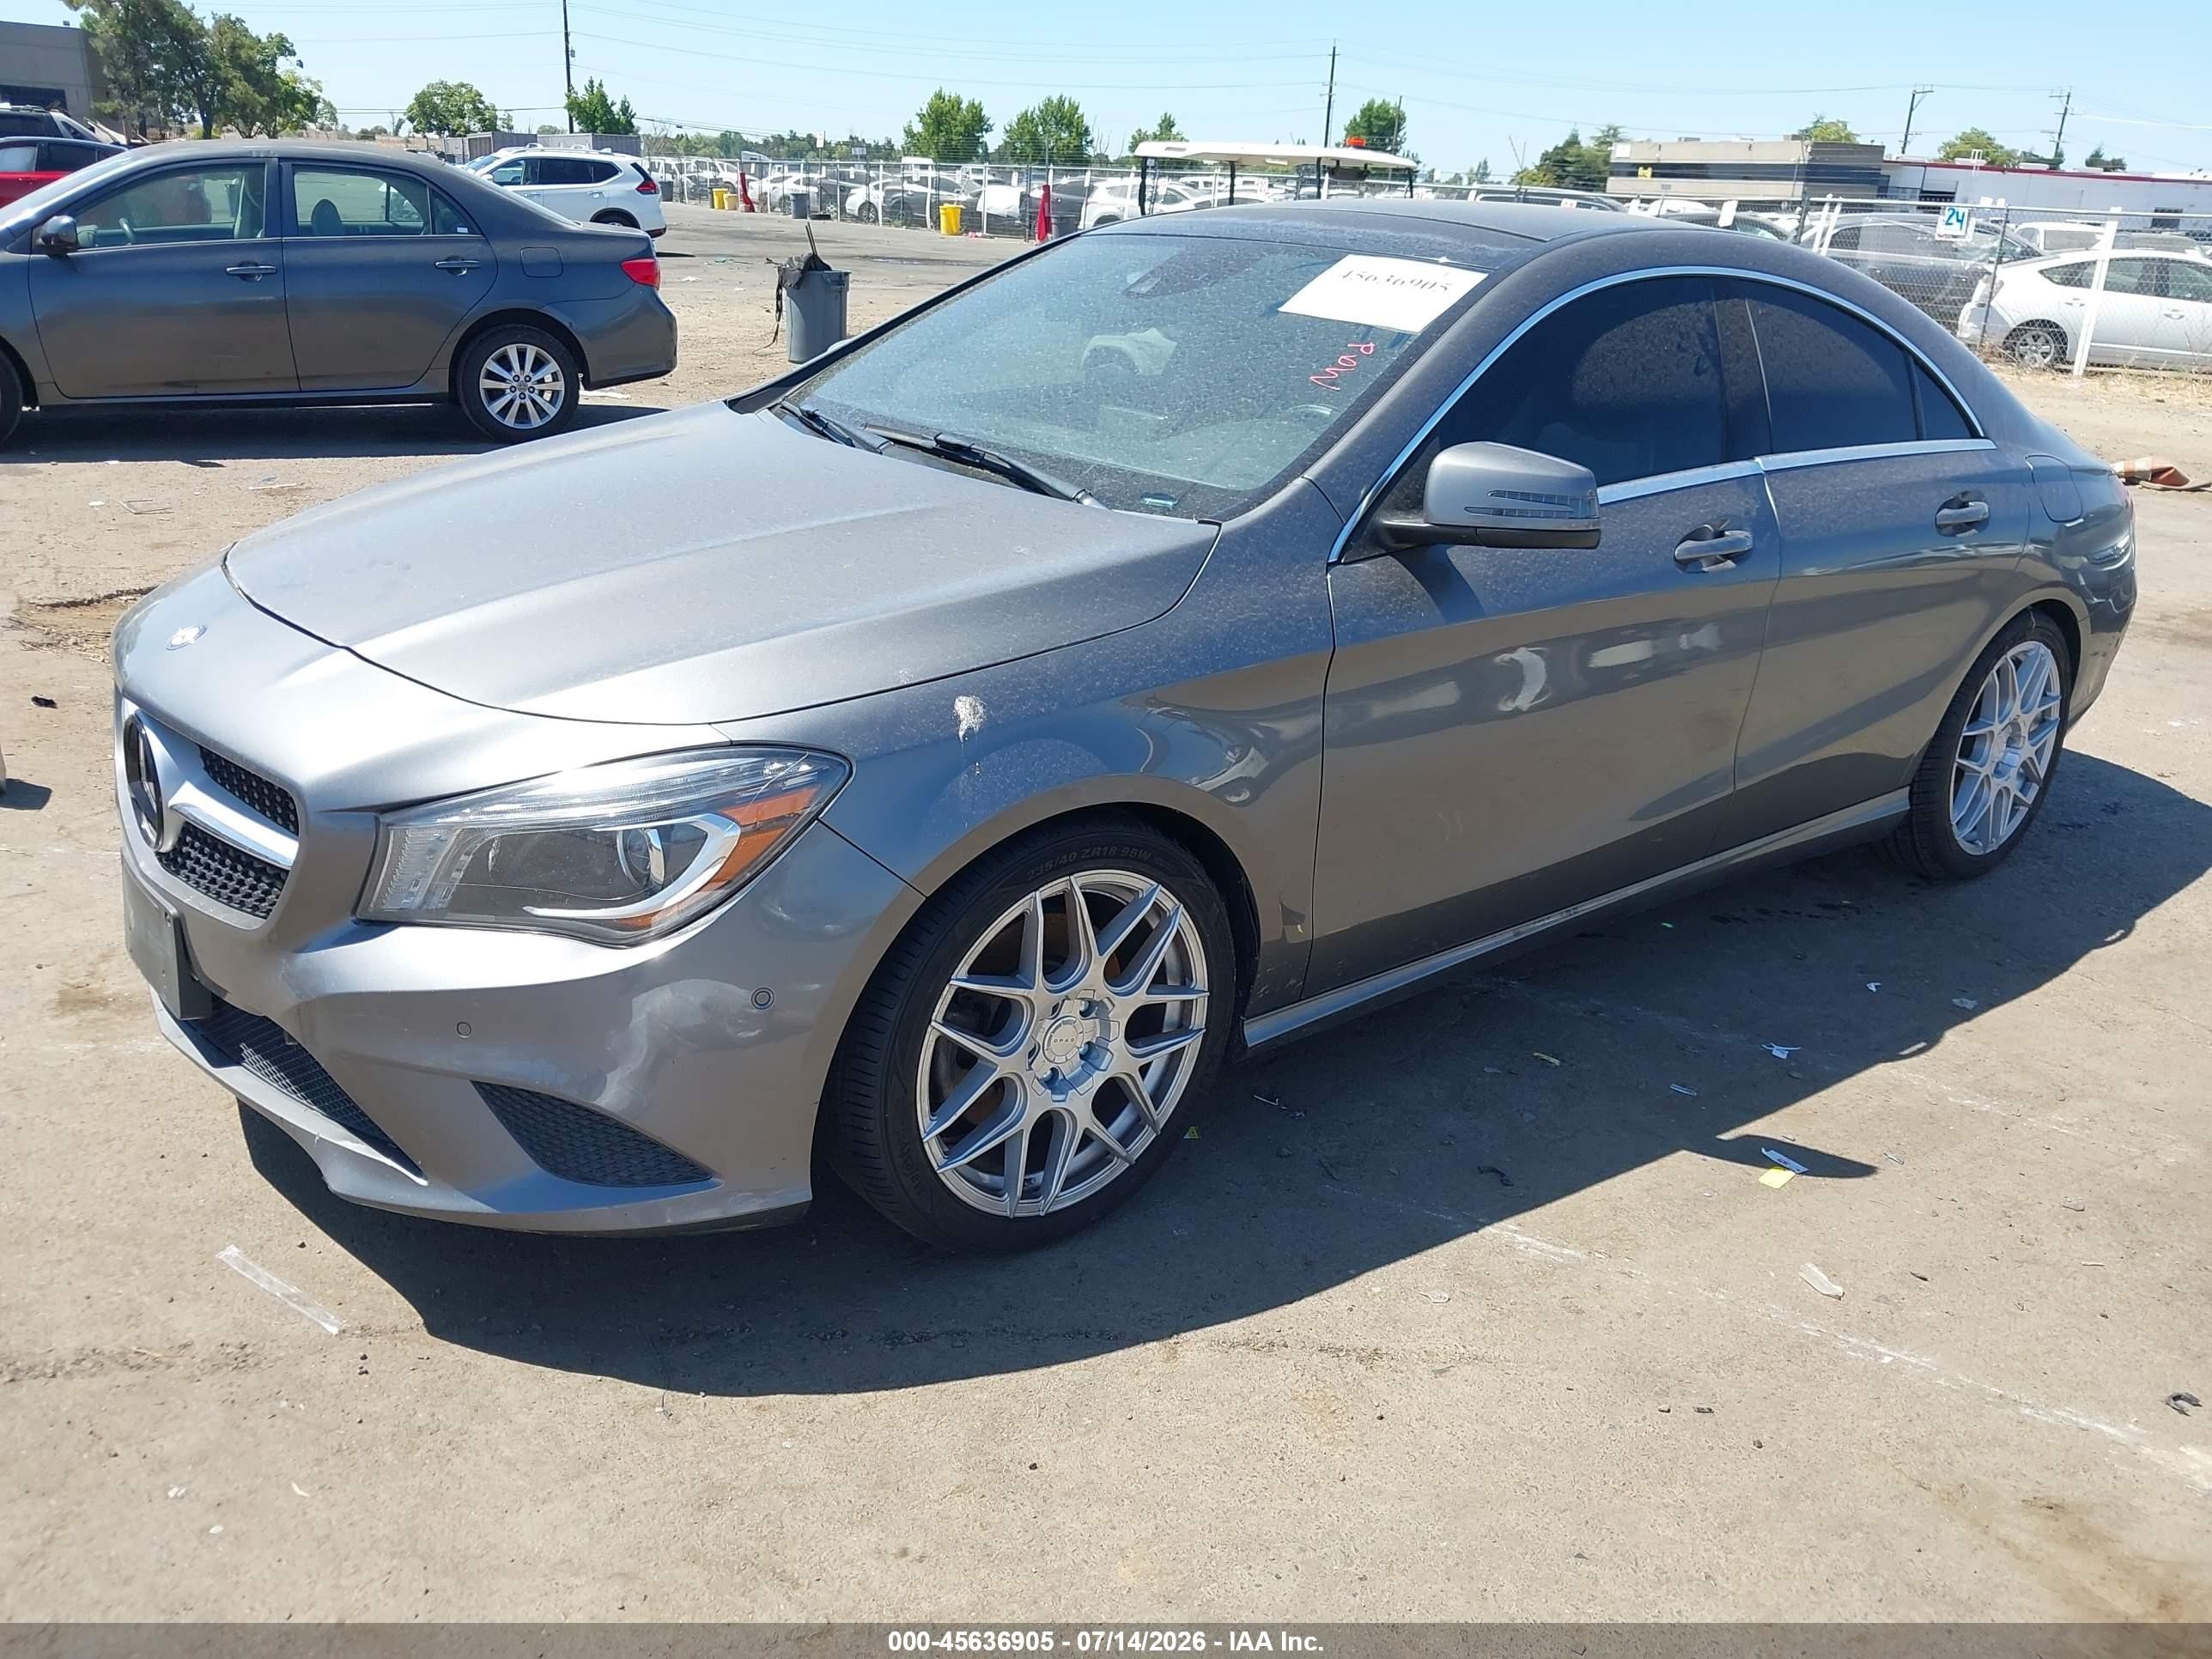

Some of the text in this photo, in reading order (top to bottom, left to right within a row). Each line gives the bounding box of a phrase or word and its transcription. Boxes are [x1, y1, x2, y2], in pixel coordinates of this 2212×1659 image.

[1944, 207, 1966, 231] 24
[1026, 846, 1153, 880] 235/40 ZR18 95W
